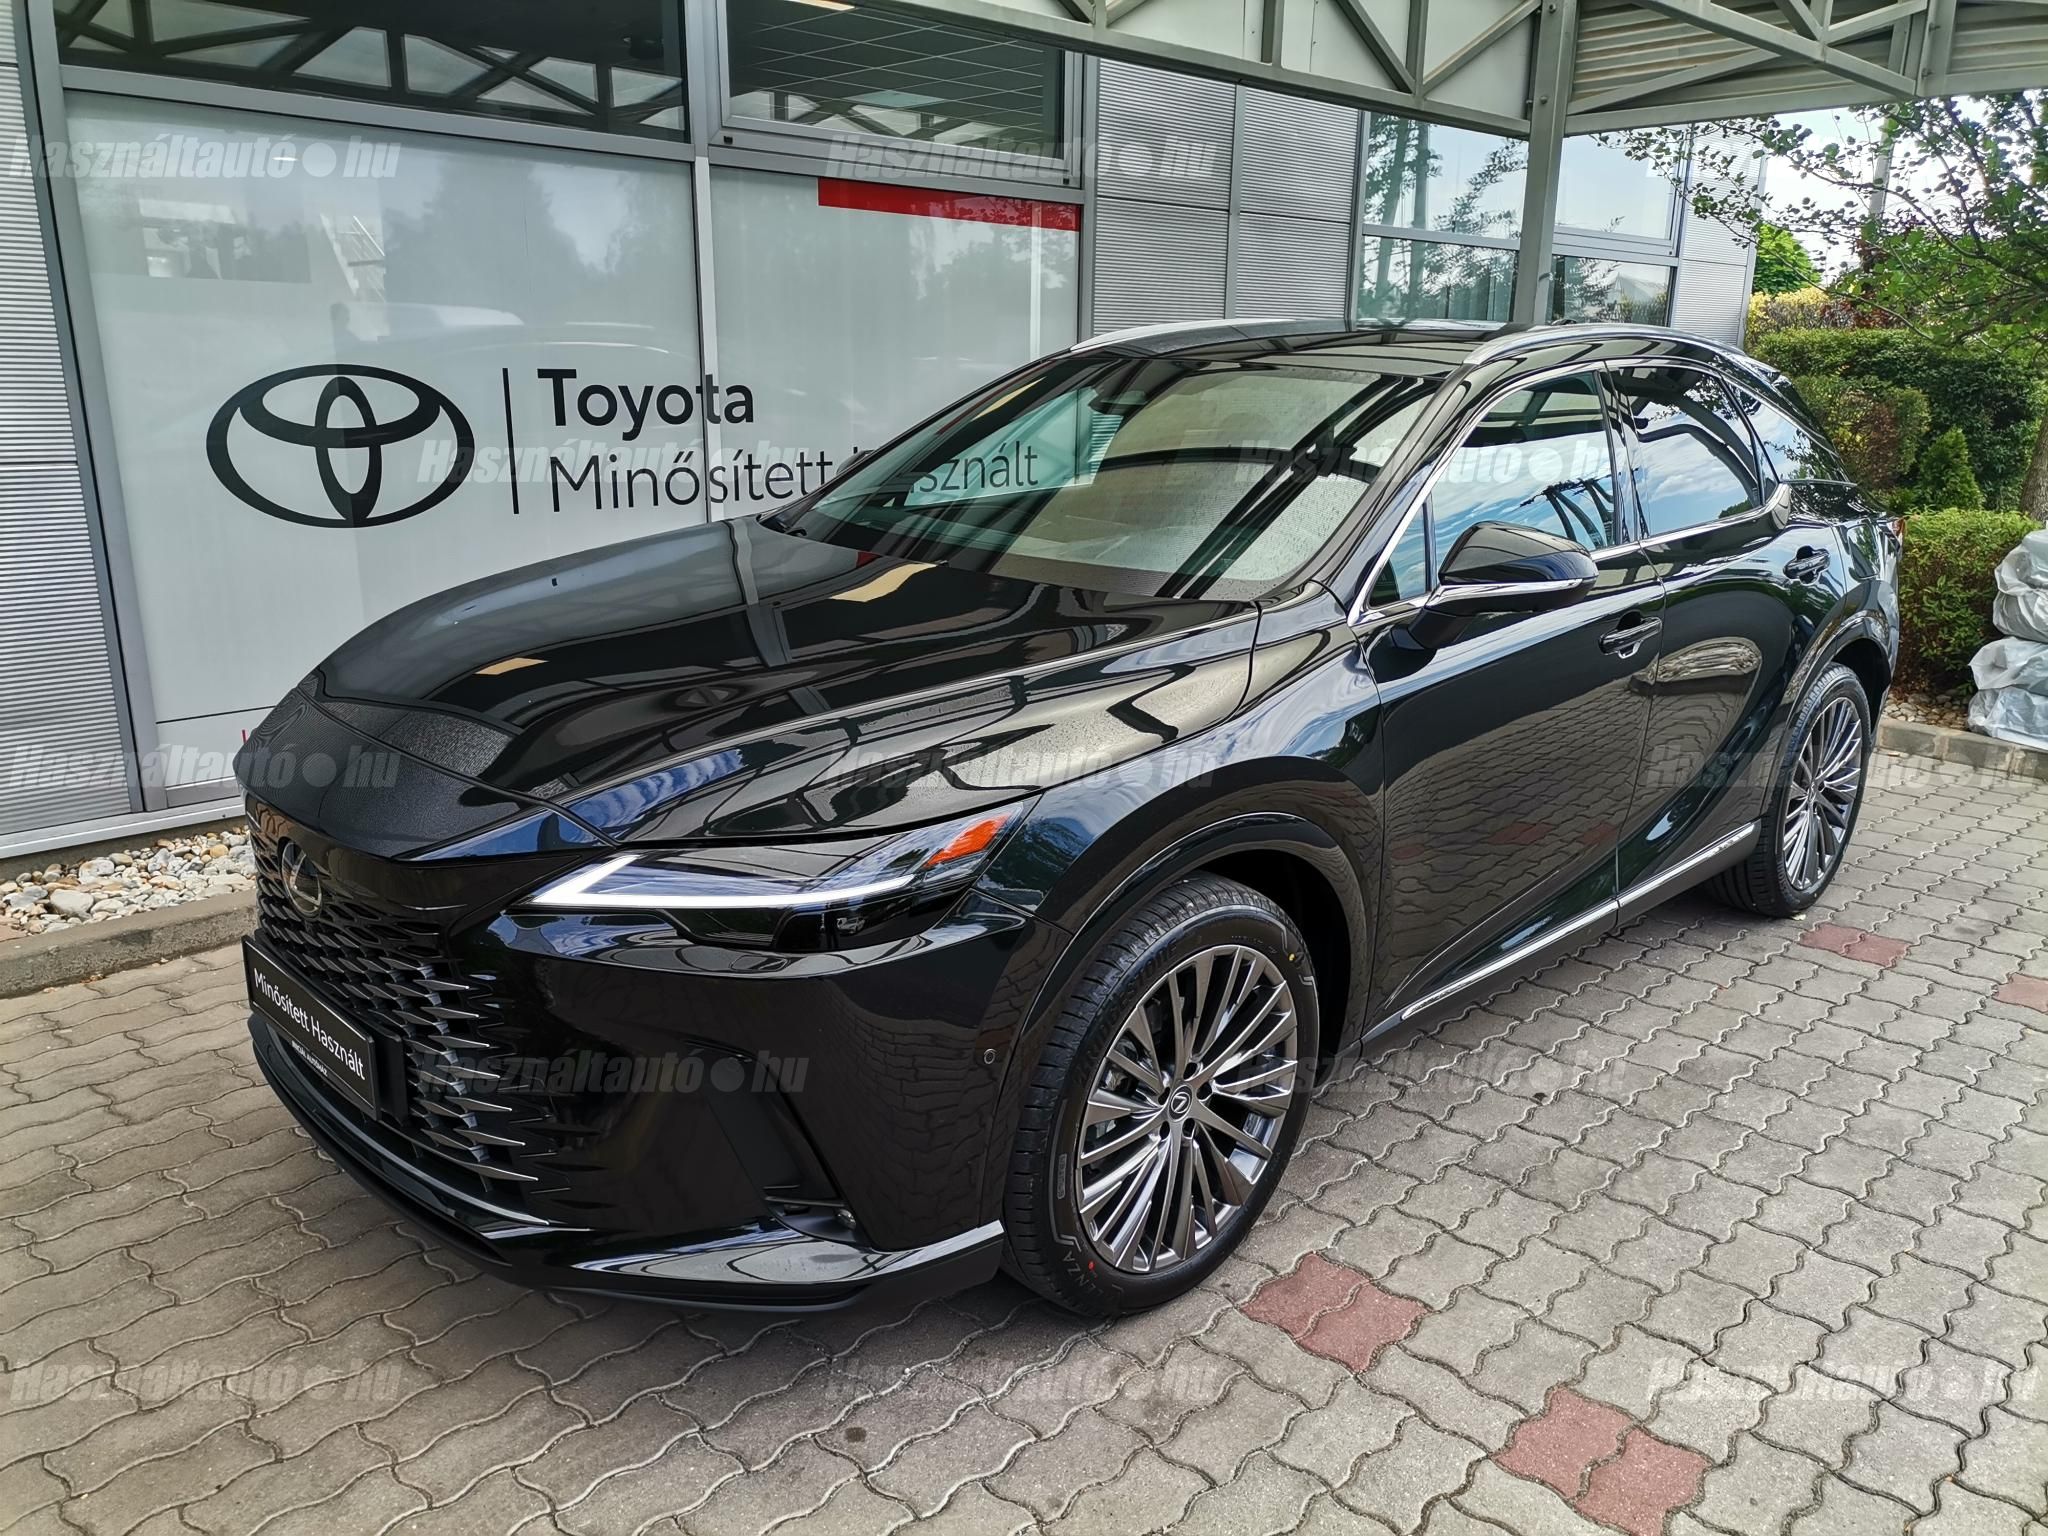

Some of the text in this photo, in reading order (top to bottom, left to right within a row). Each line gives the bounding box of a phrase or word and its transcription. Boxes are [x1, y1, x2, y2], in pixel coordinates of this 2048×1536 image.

[537, 368, 754, 441] Toyota
[550, 440, 1038, 512] Minősített sznált
[254, 967, 366, 1081] Minősített Használt
